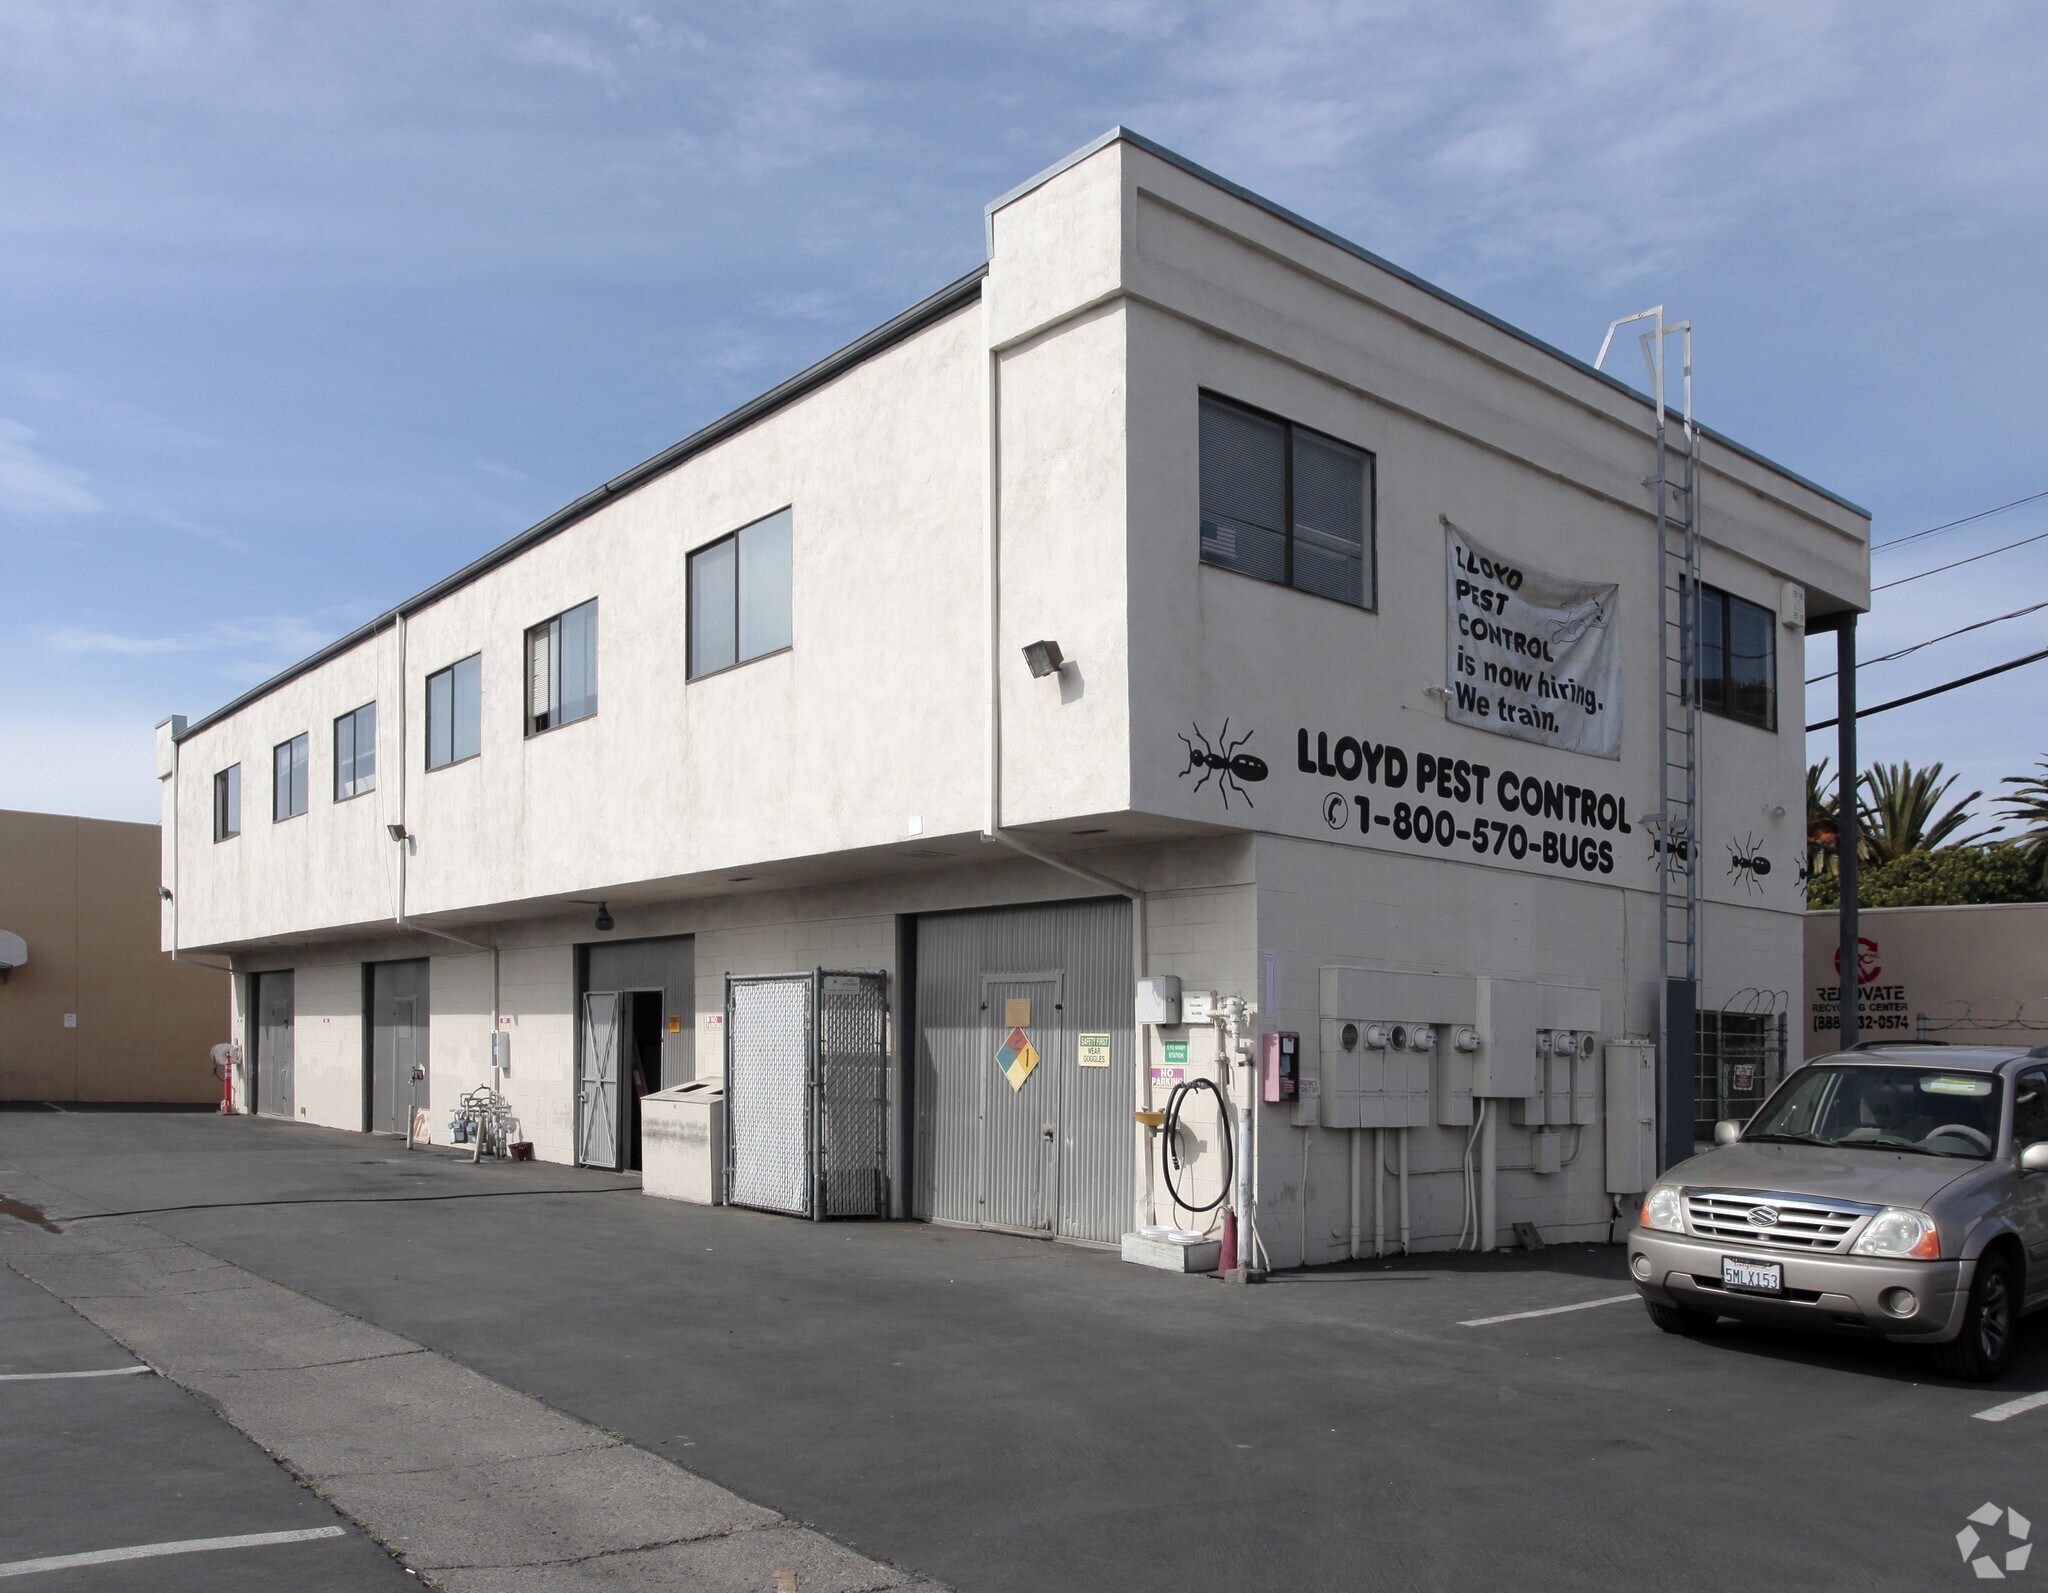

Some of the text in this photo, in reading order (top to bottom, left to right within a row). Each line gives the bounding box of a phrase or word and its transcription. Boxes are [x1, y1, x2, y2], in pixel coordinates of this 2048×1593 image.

[1456, 546, 1523, 591] LLOYD
[1456, 579, 1509, 615] PEST
[1459, 613, 1554, 662] CONTROL
[1457, 645, 1603, 715] is now hiring.
[1455, 681, 1559, 732] We train.
[1298, 728, 1632, 834] LLOYD PEST CONTROL
[1354, 795, 1614, 874] 1-800-570-BUGS
[1816, 986, 1905, 1001] REVATE
[1812, 1003, 1908, 1012] RECYG CENTER
[1813, 1015, 1841, 1032] (888
[1081, 1037, 1108, 1046] SAFETY FIRST
[1026, 1048, 1030, 1067] 1
[1083, 1055, 1105, 1063] GOGGLES
[1161, 1069, 1173, 1077] NO
[1726, 1268, 1778, 1289] 5MLX153
